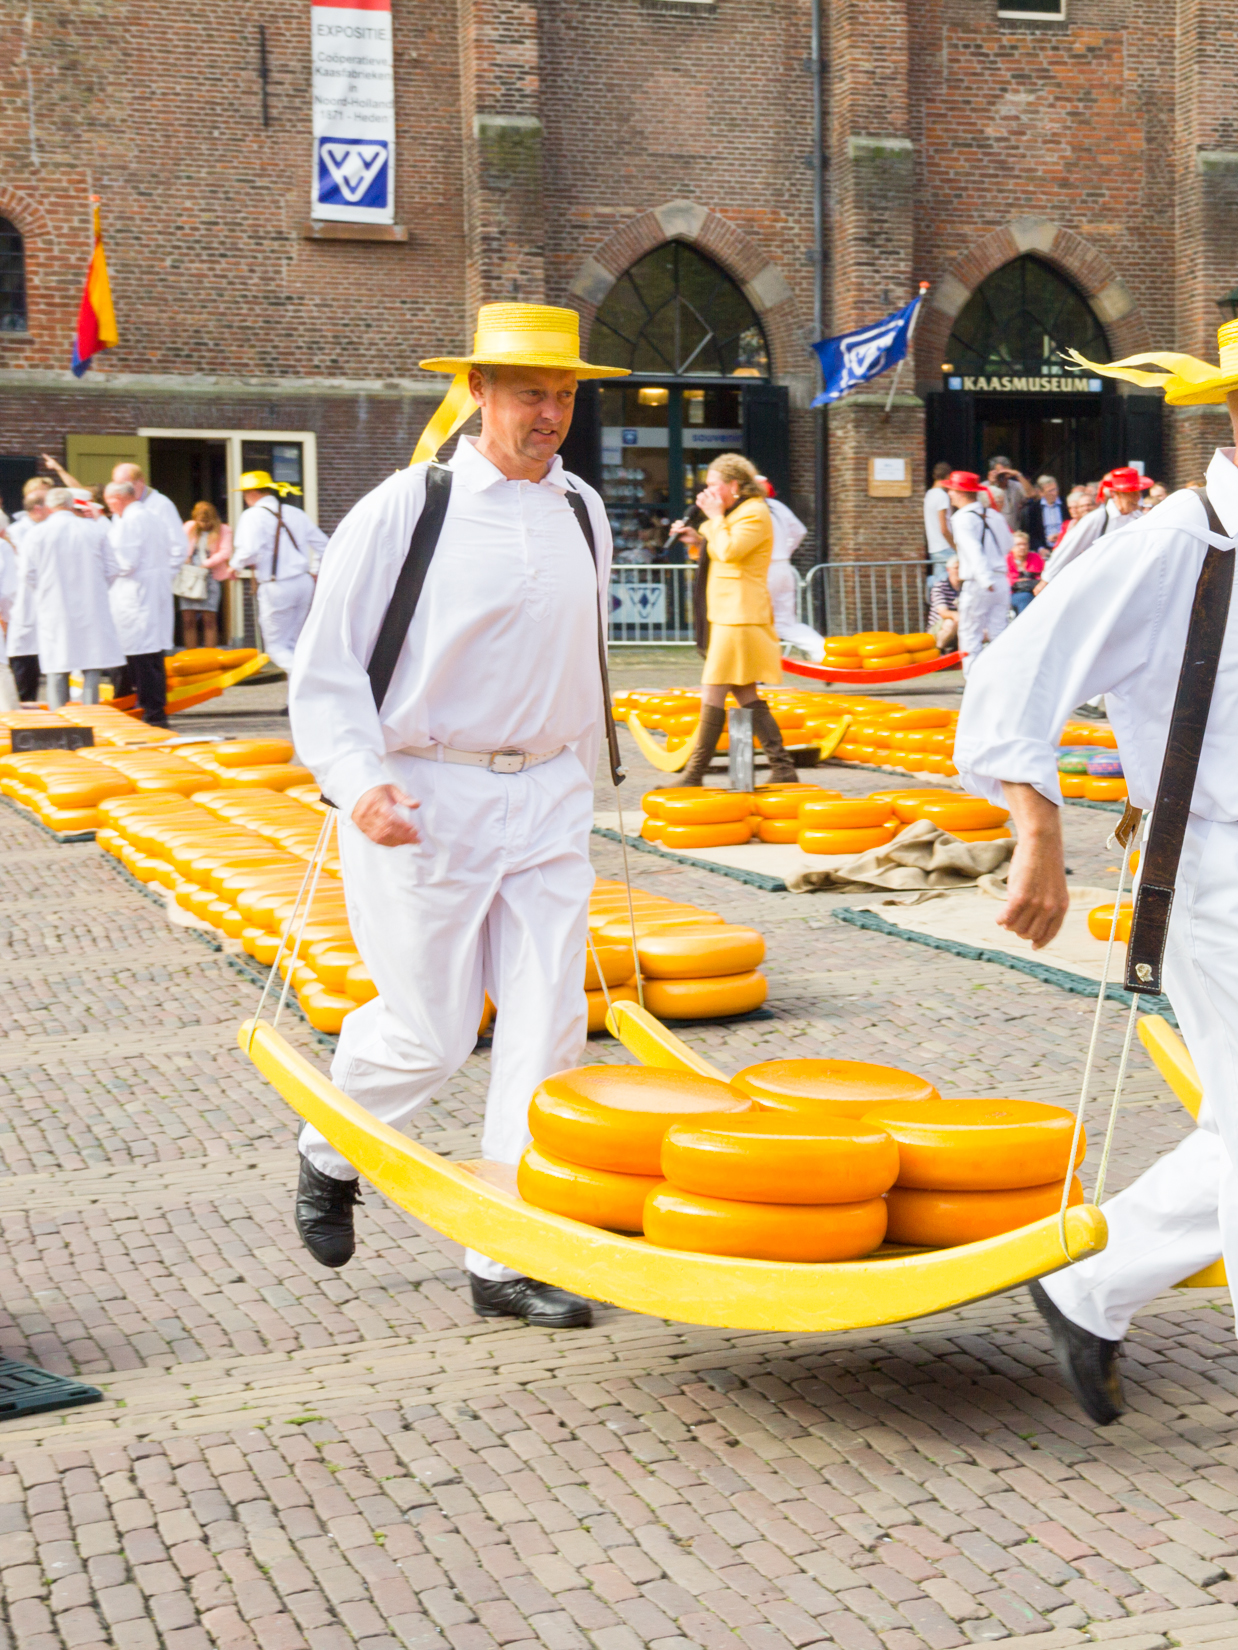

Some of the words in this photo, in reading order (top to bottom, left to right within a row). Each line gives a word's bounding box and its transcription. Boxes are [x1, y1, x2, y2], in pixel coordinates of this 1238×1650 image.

[316, 24, 387, 41] EXPOSITIE
[348, 82, 358, 93] in
[314, 95, 393, 109] Noord-Holland
[354, 111, 388, 123] Heden
[963, 376, 1090, 392] KAASMUSEUM
